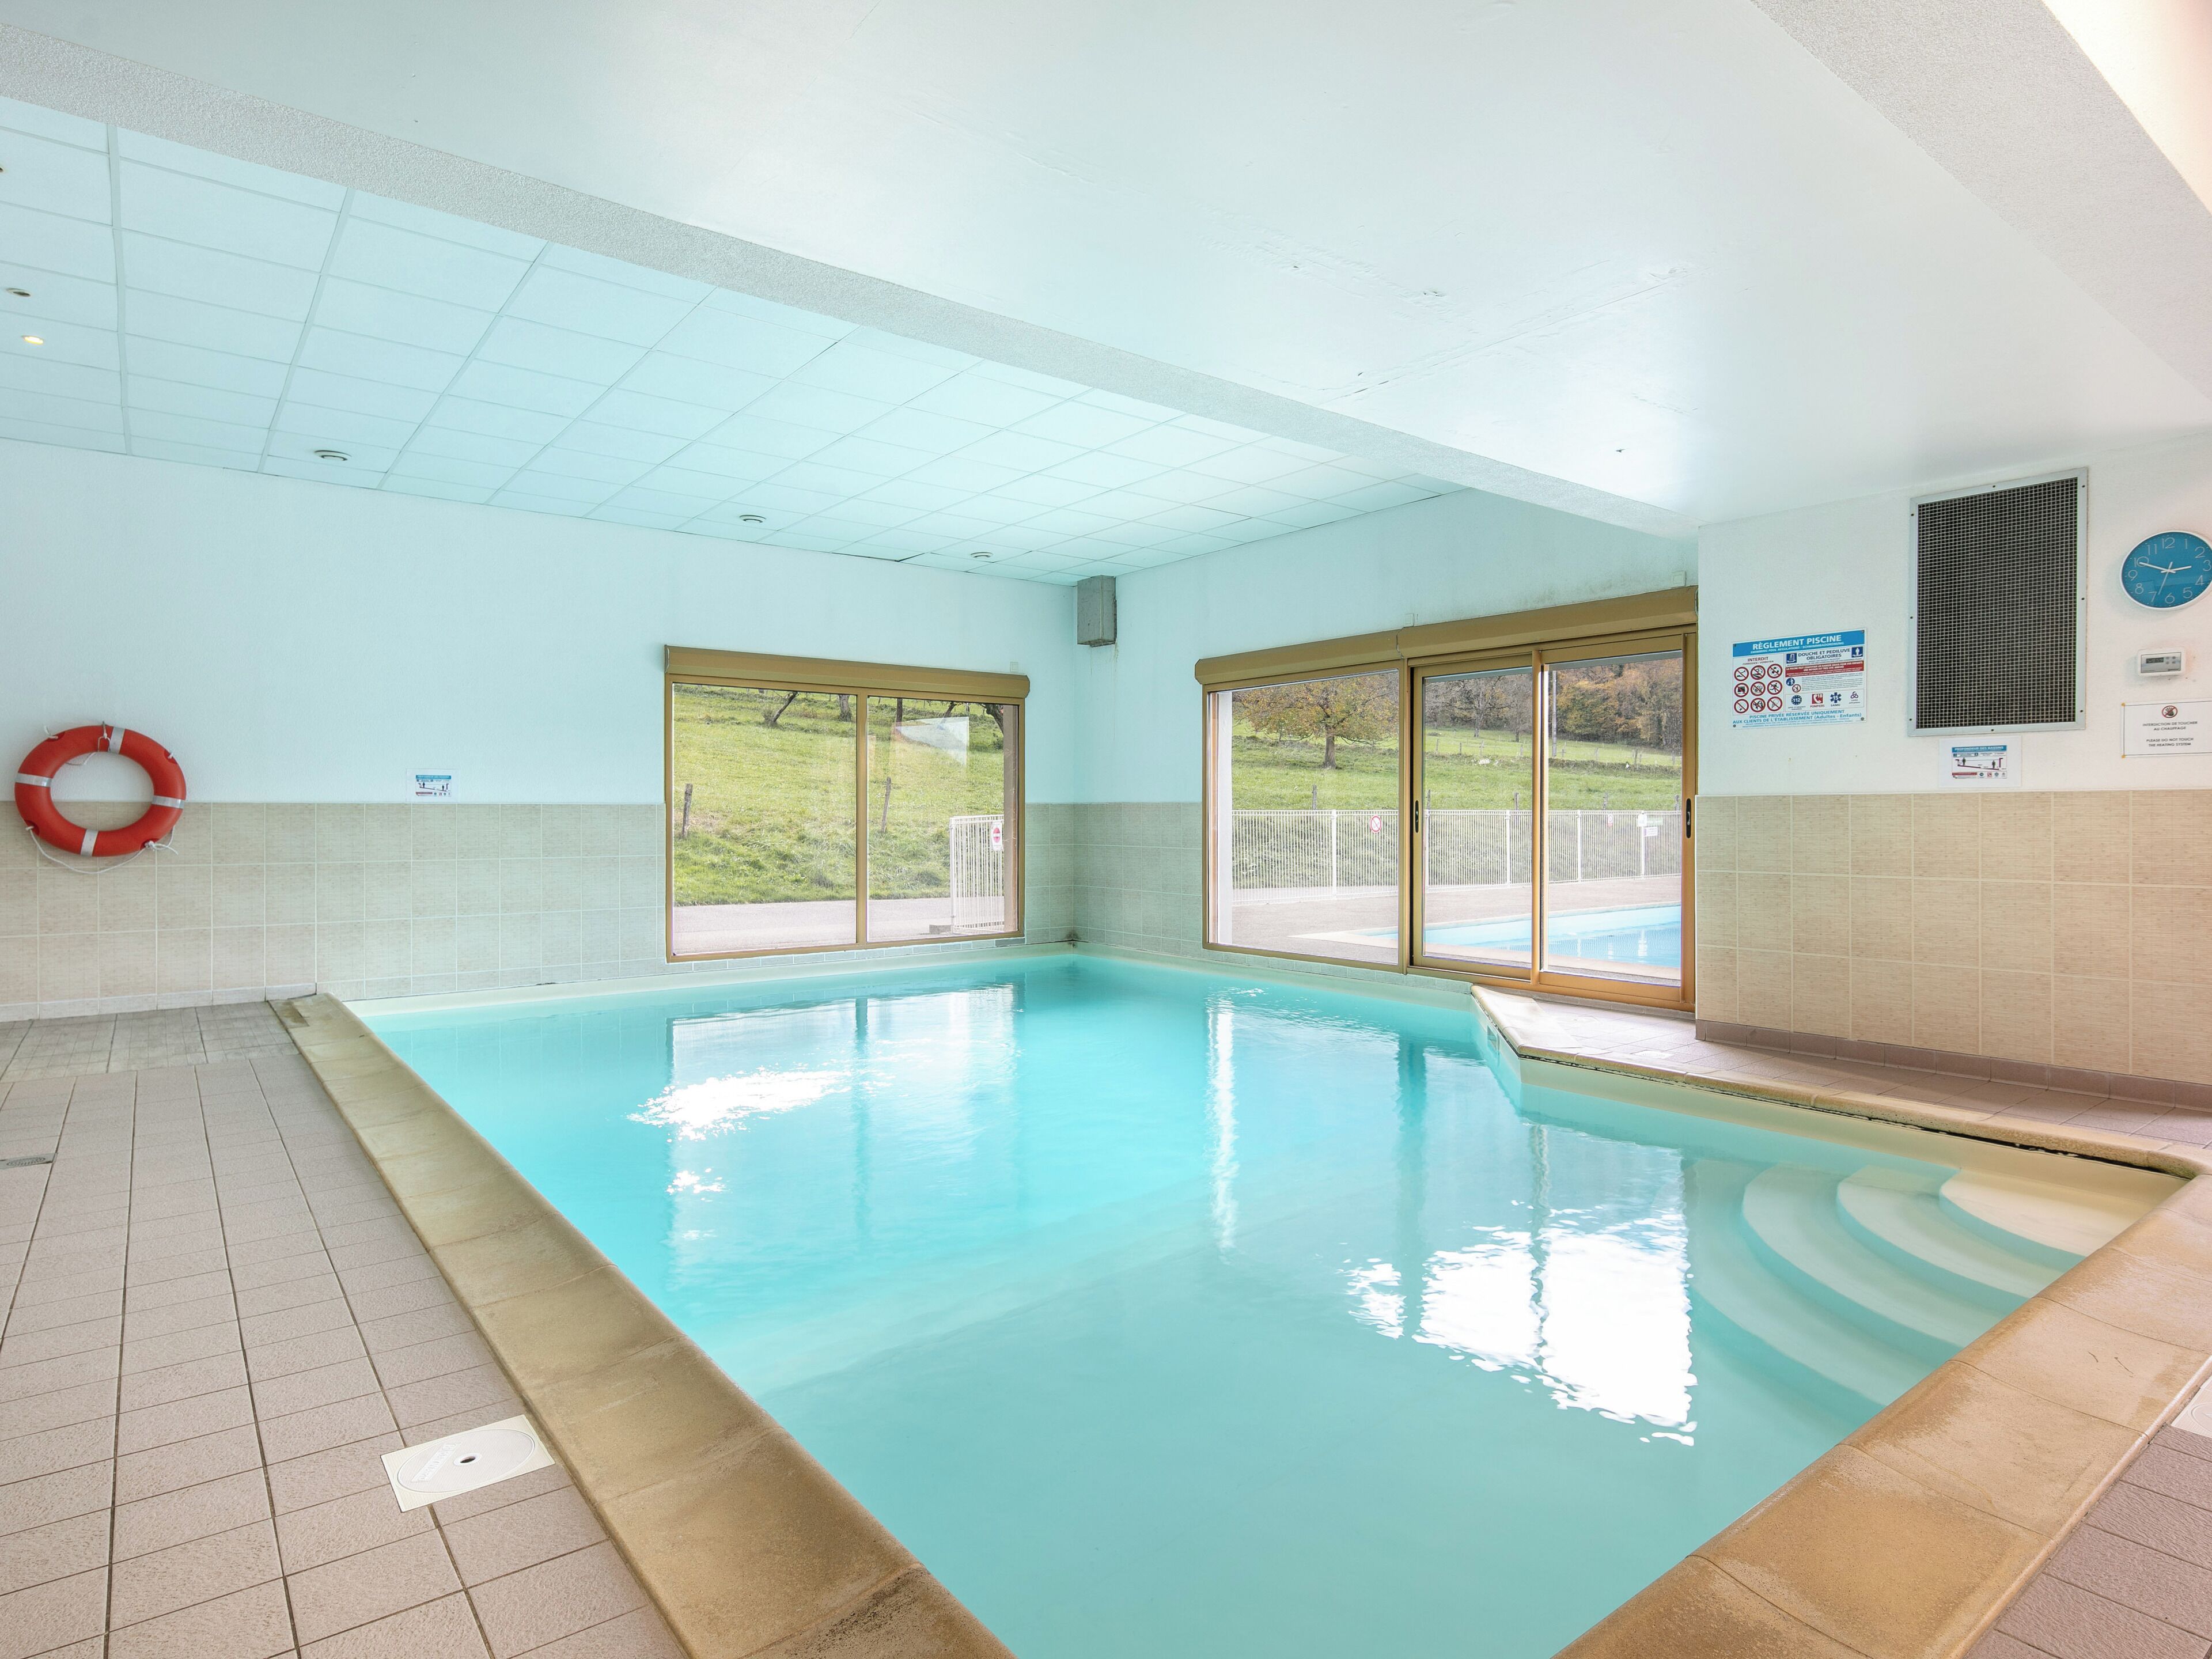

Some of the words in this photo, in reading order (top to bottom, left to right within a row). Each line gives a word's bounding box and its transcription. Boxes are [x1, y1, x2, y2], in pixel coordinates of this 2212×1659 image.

[2162, 537, 2175, 549] 12
[2184, 539, 2188, 549] 1
[2147, 544, 2157, 555] 11
[2195, 546, 2206, 558] 2
[2134, 556, 2150, 567] 10
[2203, 559, 2212, 571] 3
[2128, 570, 2138, 581] 9
[2195, 575, 2205, 586] 4
[2135, 582, 2144, 594] 8
[2183, 587, 2192, 599] 5
[2147, 591, 2157, 603] 7
[2165, 592, 2175, 604] 6
[1752, 639, 1804, 650] RÈGLEMENT
[1806, 635, 1842, 645] PISCINE
